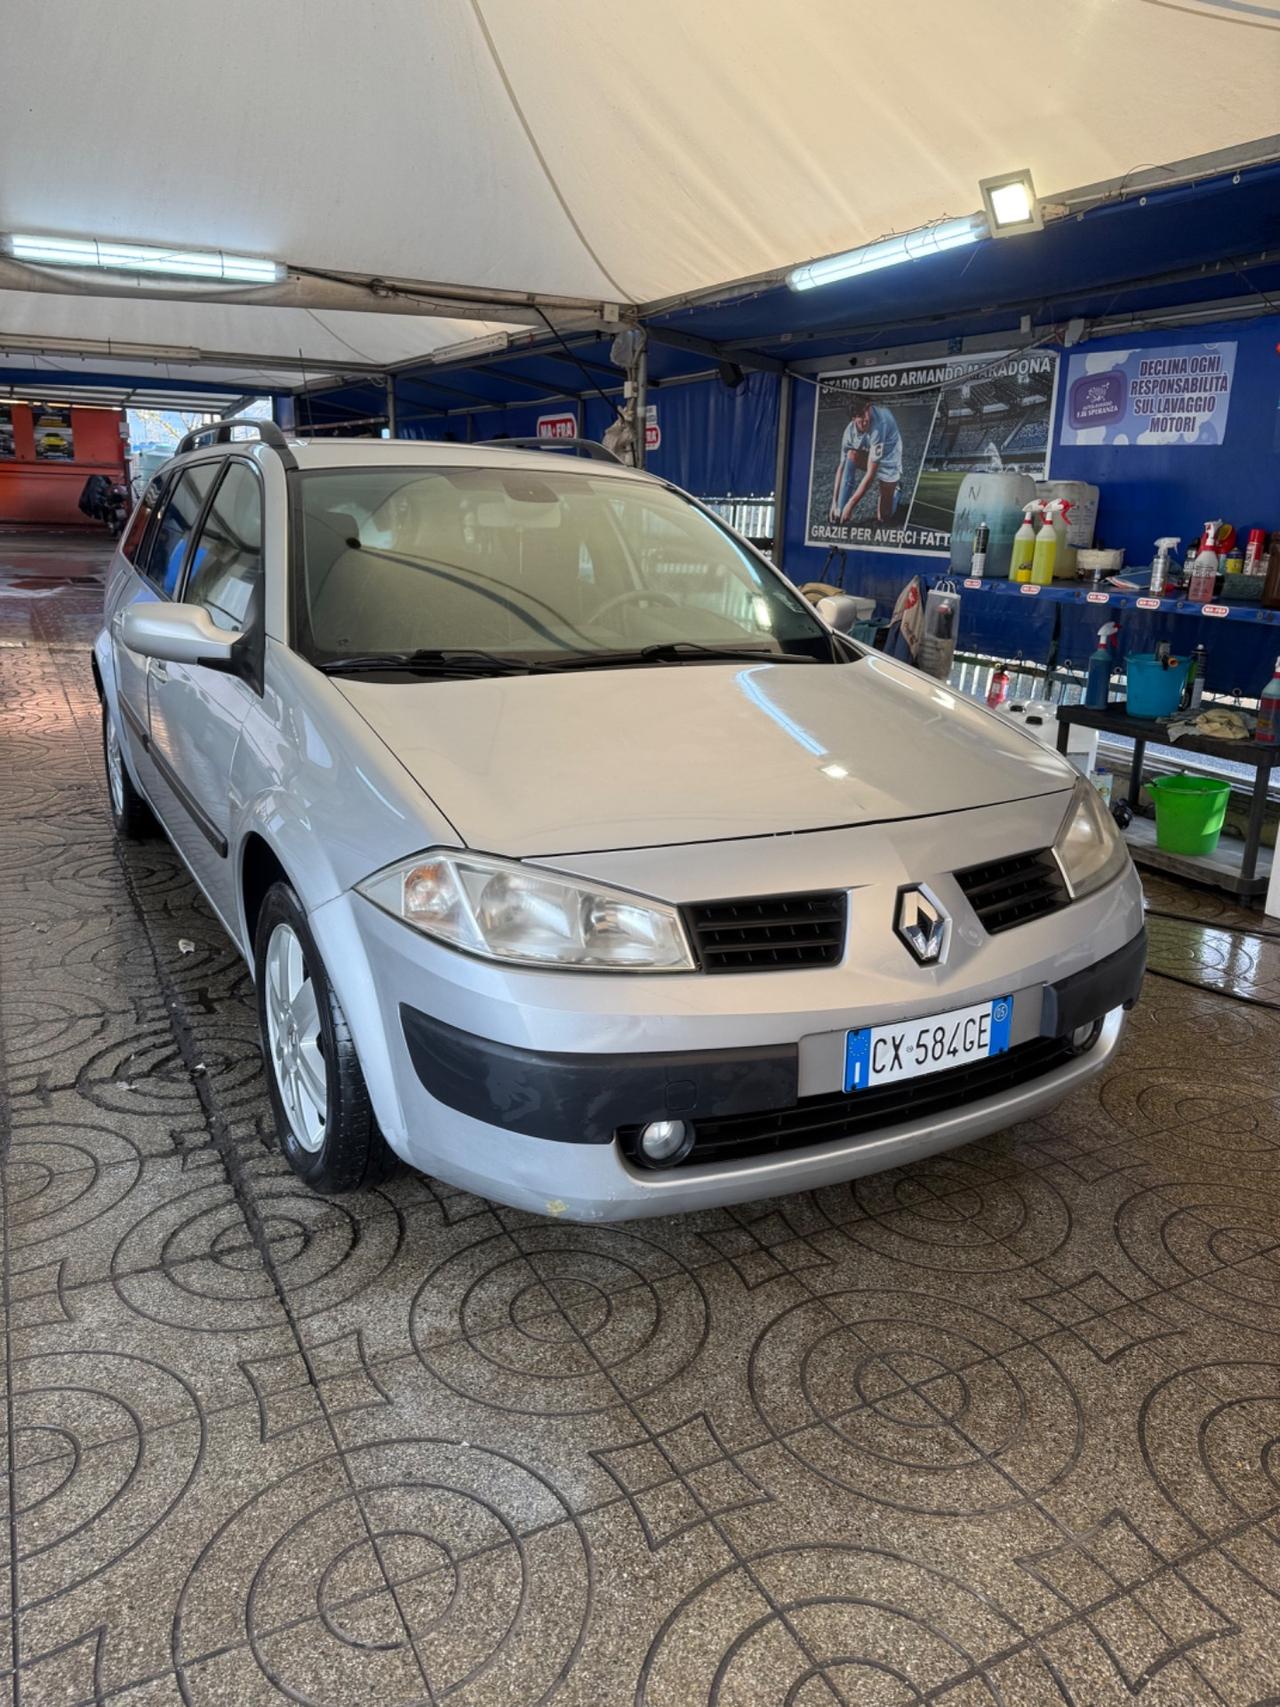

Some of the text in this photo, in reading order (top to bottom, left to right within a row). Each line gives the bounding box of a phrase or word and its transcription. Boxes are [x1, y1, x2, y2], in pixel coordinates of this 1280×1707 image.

[1140, 355, 1221, 376] DECLINA OGNI
[862, 373, 897, 390] DIEGO
[899, 365, 963, 386] ARMANDO
[1130, 372, 1228, 396] RESPONSABILITÀ
[1134, 396, 1217, 414] SUL LAVAGGIO
[1149, 416, 1197, 433] MOTORI
[811, 525, 952, 547] GRAZIE PER AVERCI FATT
